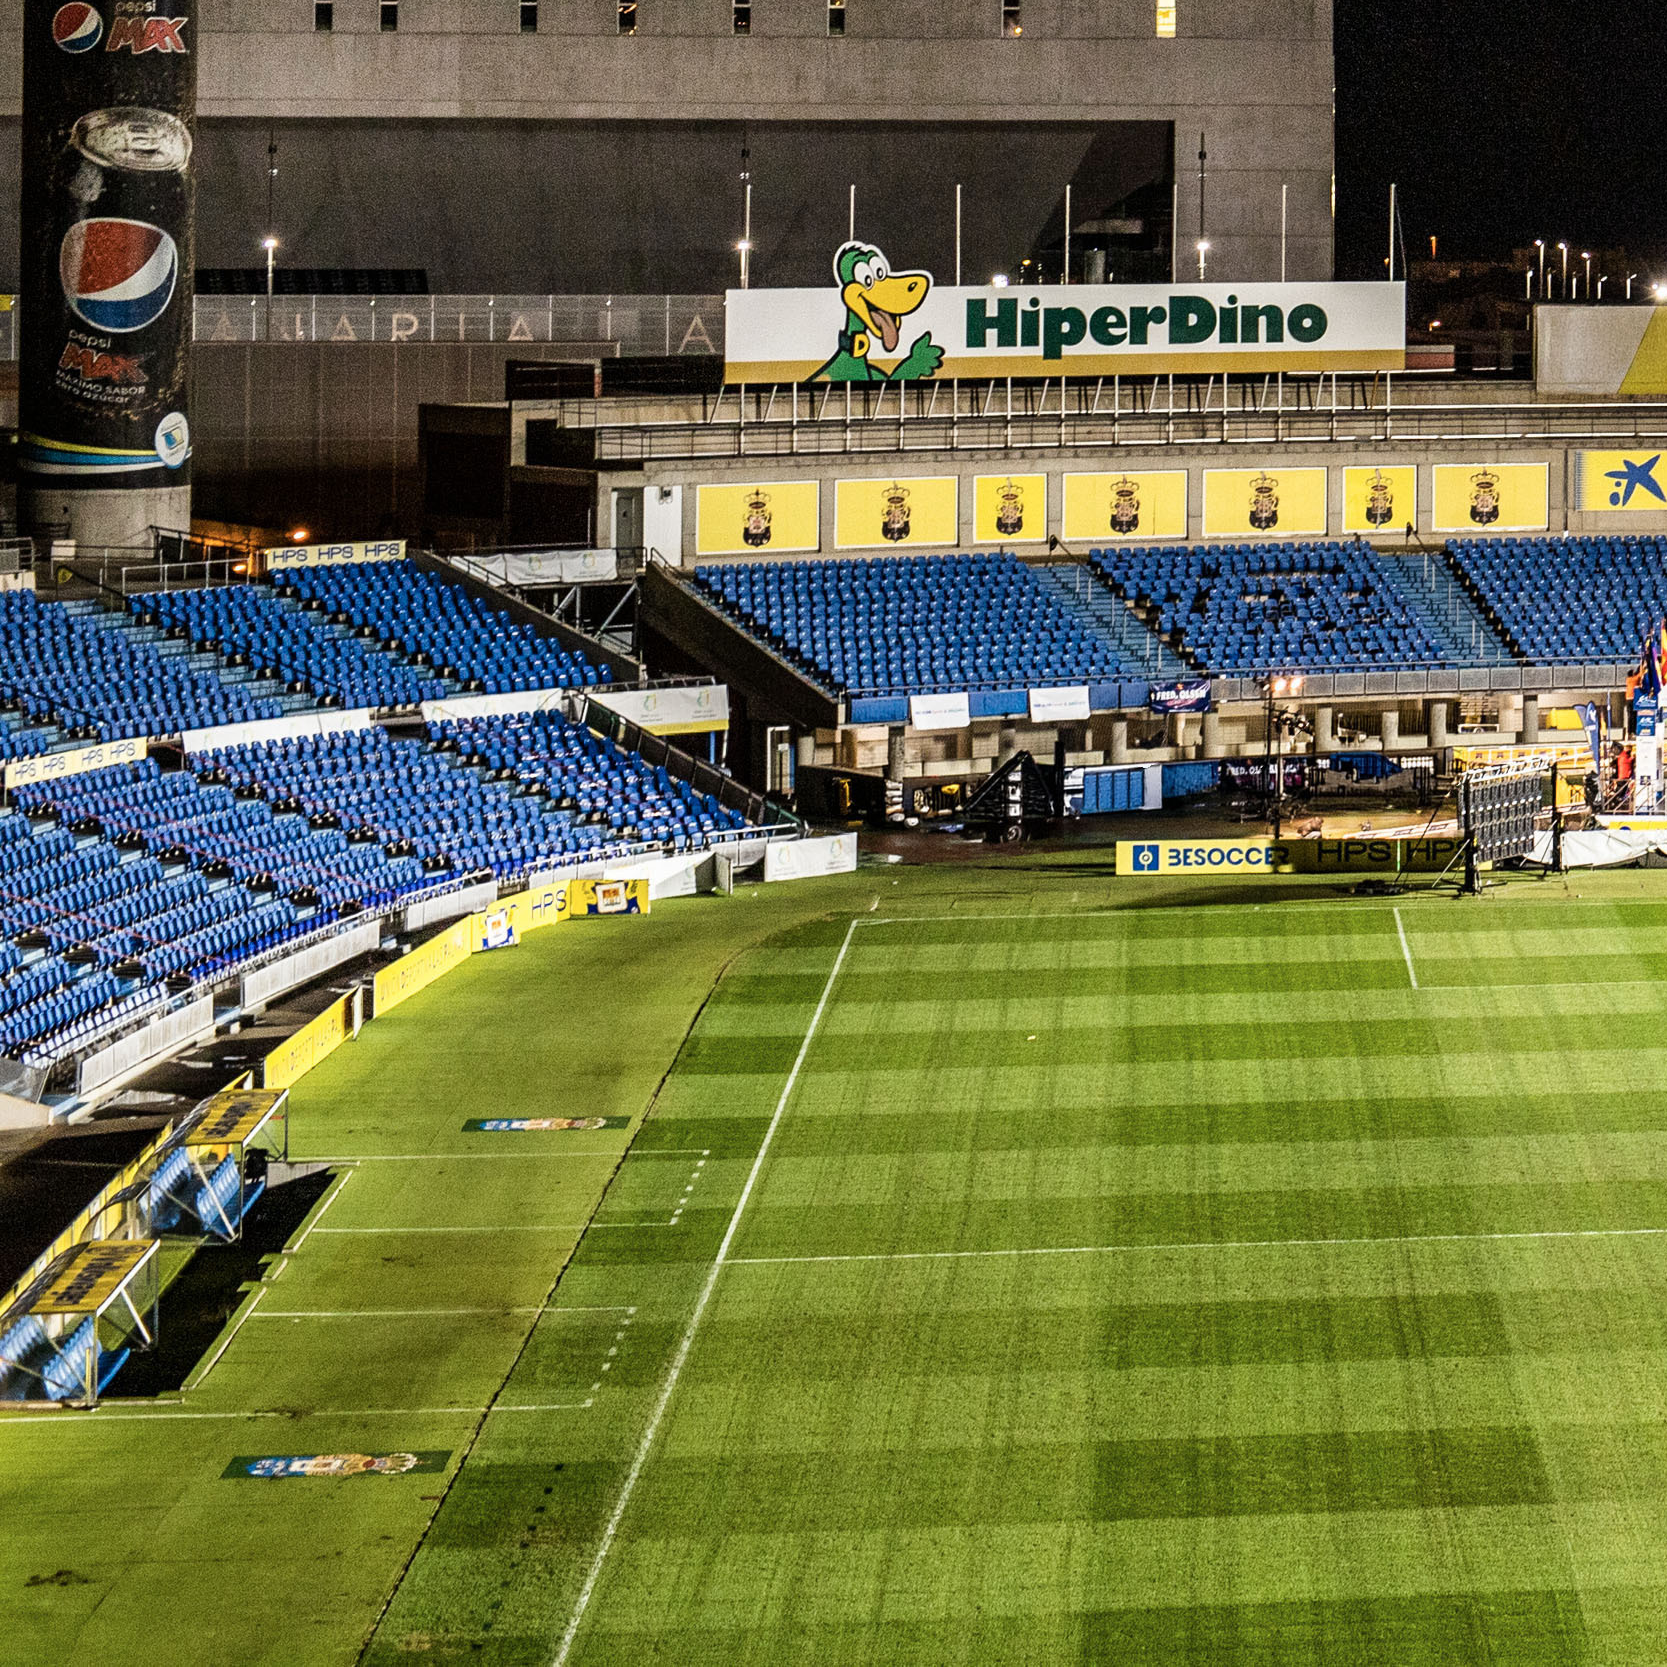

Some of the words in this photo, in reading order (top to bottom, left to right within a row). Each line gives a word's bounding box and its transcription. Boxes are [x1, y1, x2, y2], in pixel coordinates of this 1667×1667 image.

[115, 0, 156, 13] pepsi
[105, 16, 189, 55] MAX
[966, 294, 1328, 360] HiperDino
[273, 549, 308, 563] HPS
[318, 546, 354, 560] HPS
[364, 542, 400, 557] HPS
[1168, 845, 1290, 866] BESOCCER
[1317, 841, 1391, 863] HPS
[531, 889, 567, 921] HPS
